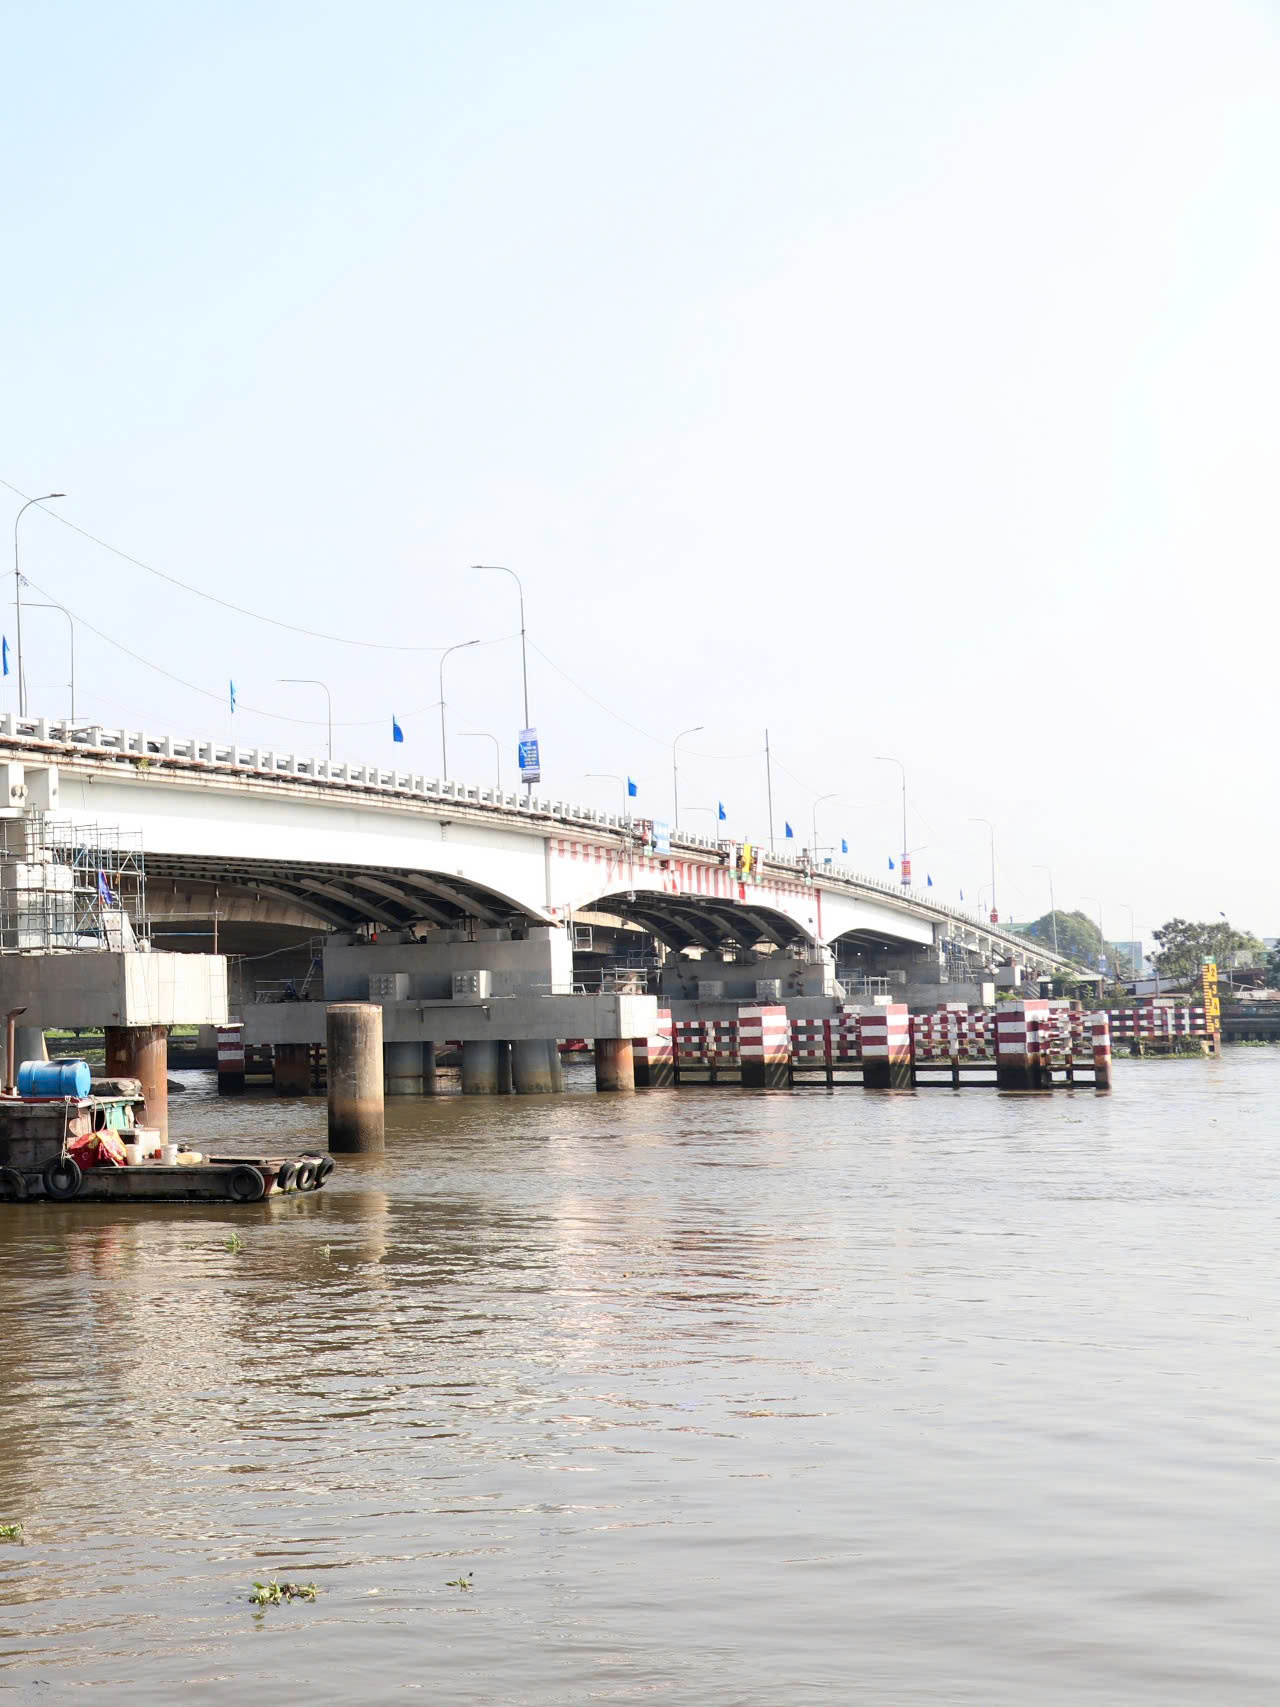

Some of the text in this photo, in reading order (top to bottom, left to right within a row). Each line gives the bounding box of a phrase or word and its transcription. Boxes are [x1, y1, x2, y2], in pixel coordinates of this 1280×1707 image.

[1210, 968, 1216, 977] 2
[1211, 984, 1217, 995] 3
[1214, 1018, 1220, 1029] 5
